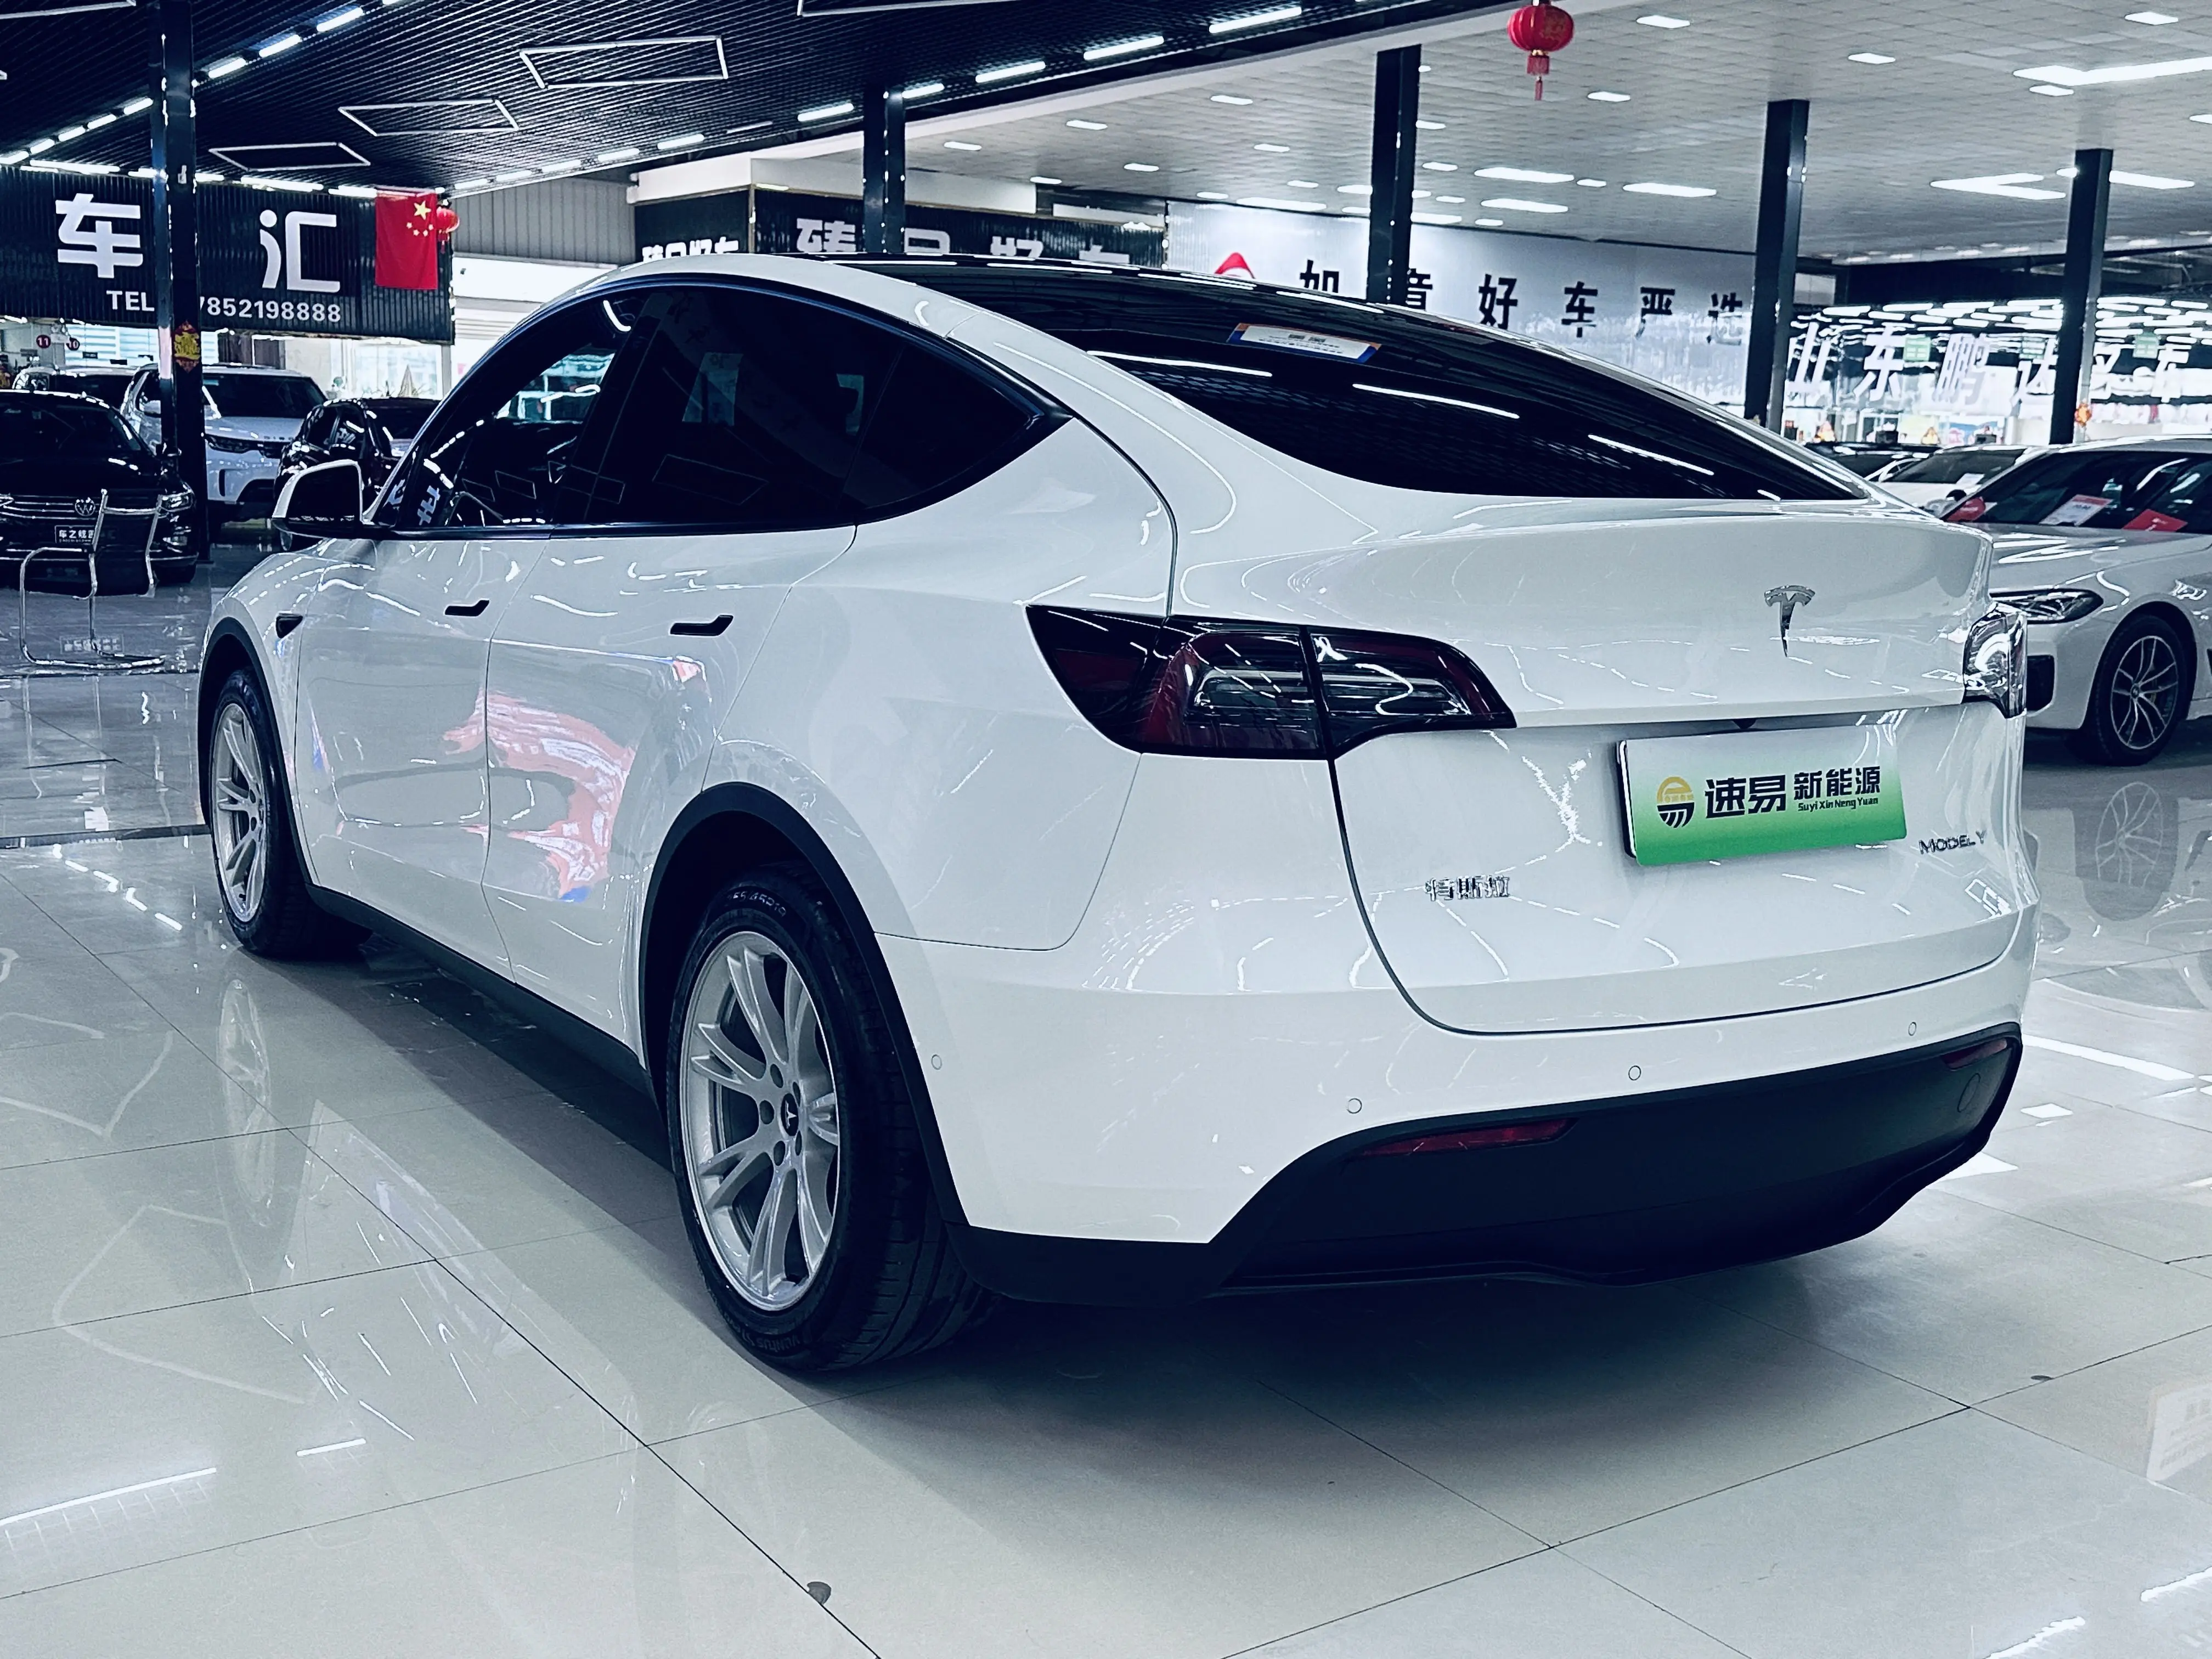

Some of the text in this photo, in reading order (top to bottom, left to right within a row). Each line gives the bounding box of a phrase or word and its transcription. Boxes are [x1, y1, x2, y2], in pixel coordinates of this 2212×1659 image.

[106, 290, 155, 312] TEL
[1819, 799, 1833, 809] Xin
[1835, 799, 1857, 809] Neng
[1857, 797, 1878, 806] Yuan
[1918, 830, 1987, 854] MODEL Y
[1424, 874, 1510, 901] 特斯拉
